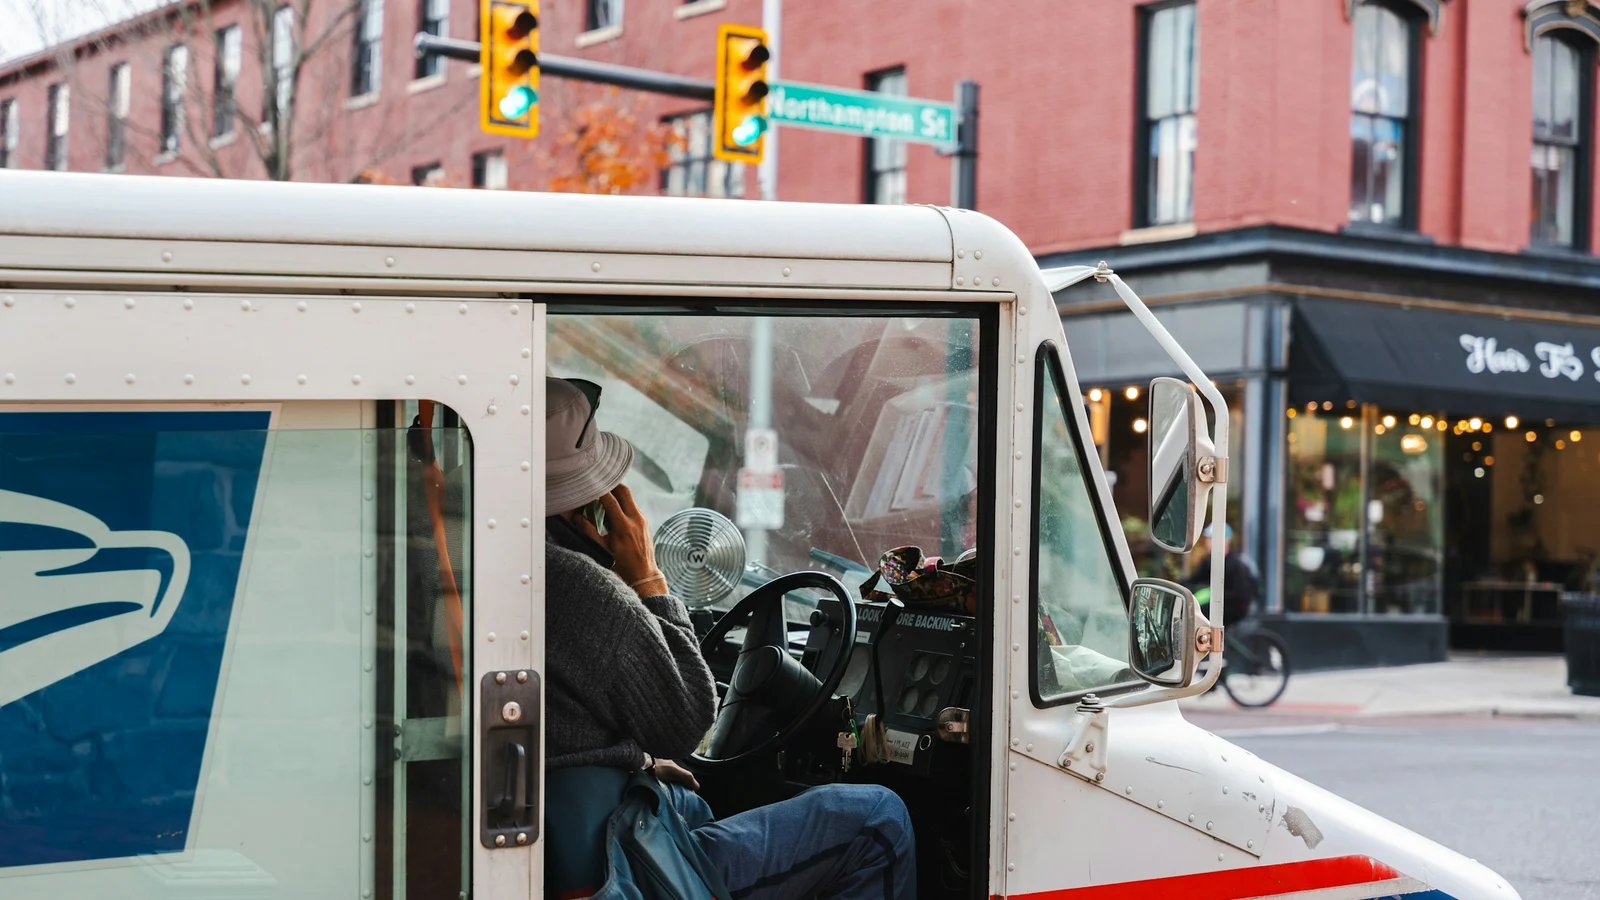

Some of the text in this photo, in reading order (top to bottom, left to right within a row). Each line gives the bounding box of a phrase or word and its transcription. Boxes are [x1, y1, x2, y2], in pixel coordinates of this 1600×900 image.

[768, 86, 948, 138] Northampton St
[857, 607, 881, 622] LOOK
[915, 614, 956, 632] BACKING
